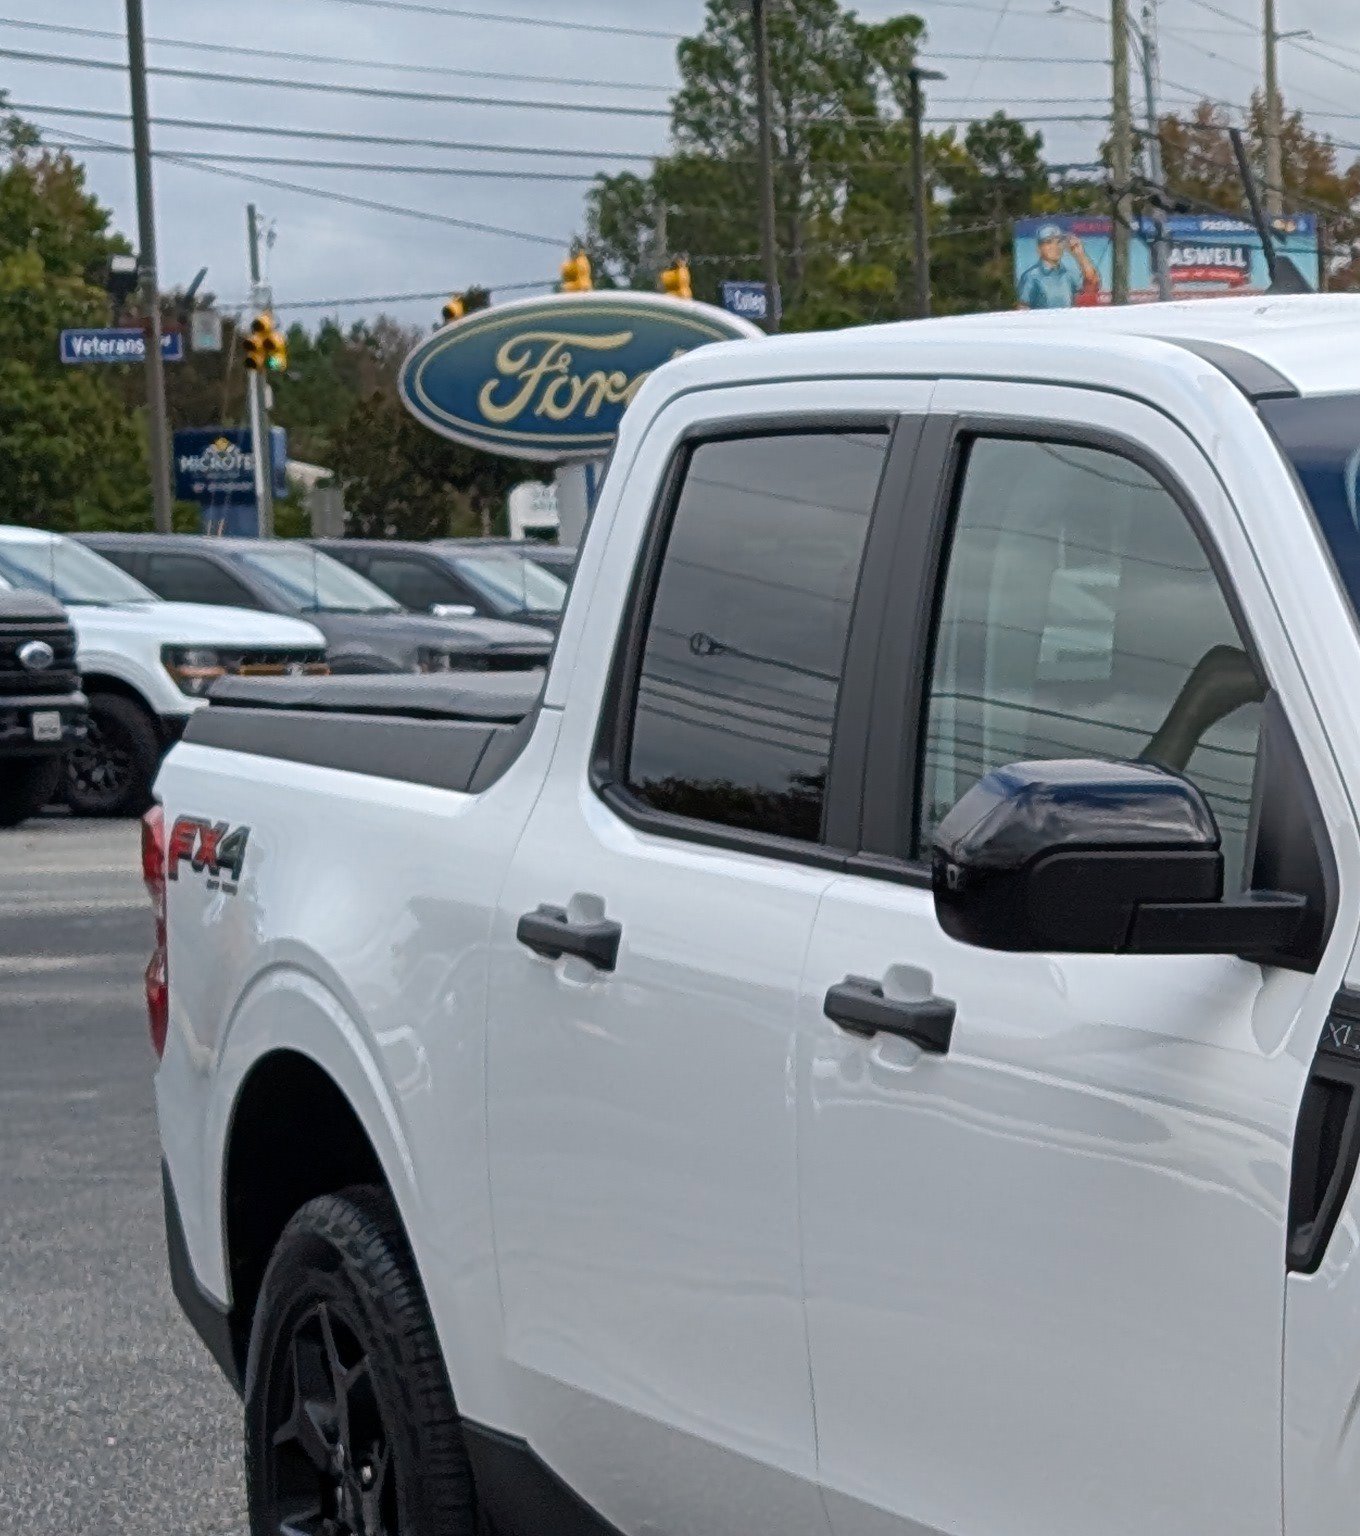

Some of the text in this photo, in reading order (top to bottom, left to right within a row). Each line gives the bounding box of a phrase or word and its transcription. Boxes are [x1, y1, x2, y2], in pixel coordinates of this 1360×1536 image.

[1167, 247, 1248, 268] ASWELL
[72, 335, 146, 356] Veterans
[479, 330, 686, 423] For
[168, 814, 252, 881] FX4
